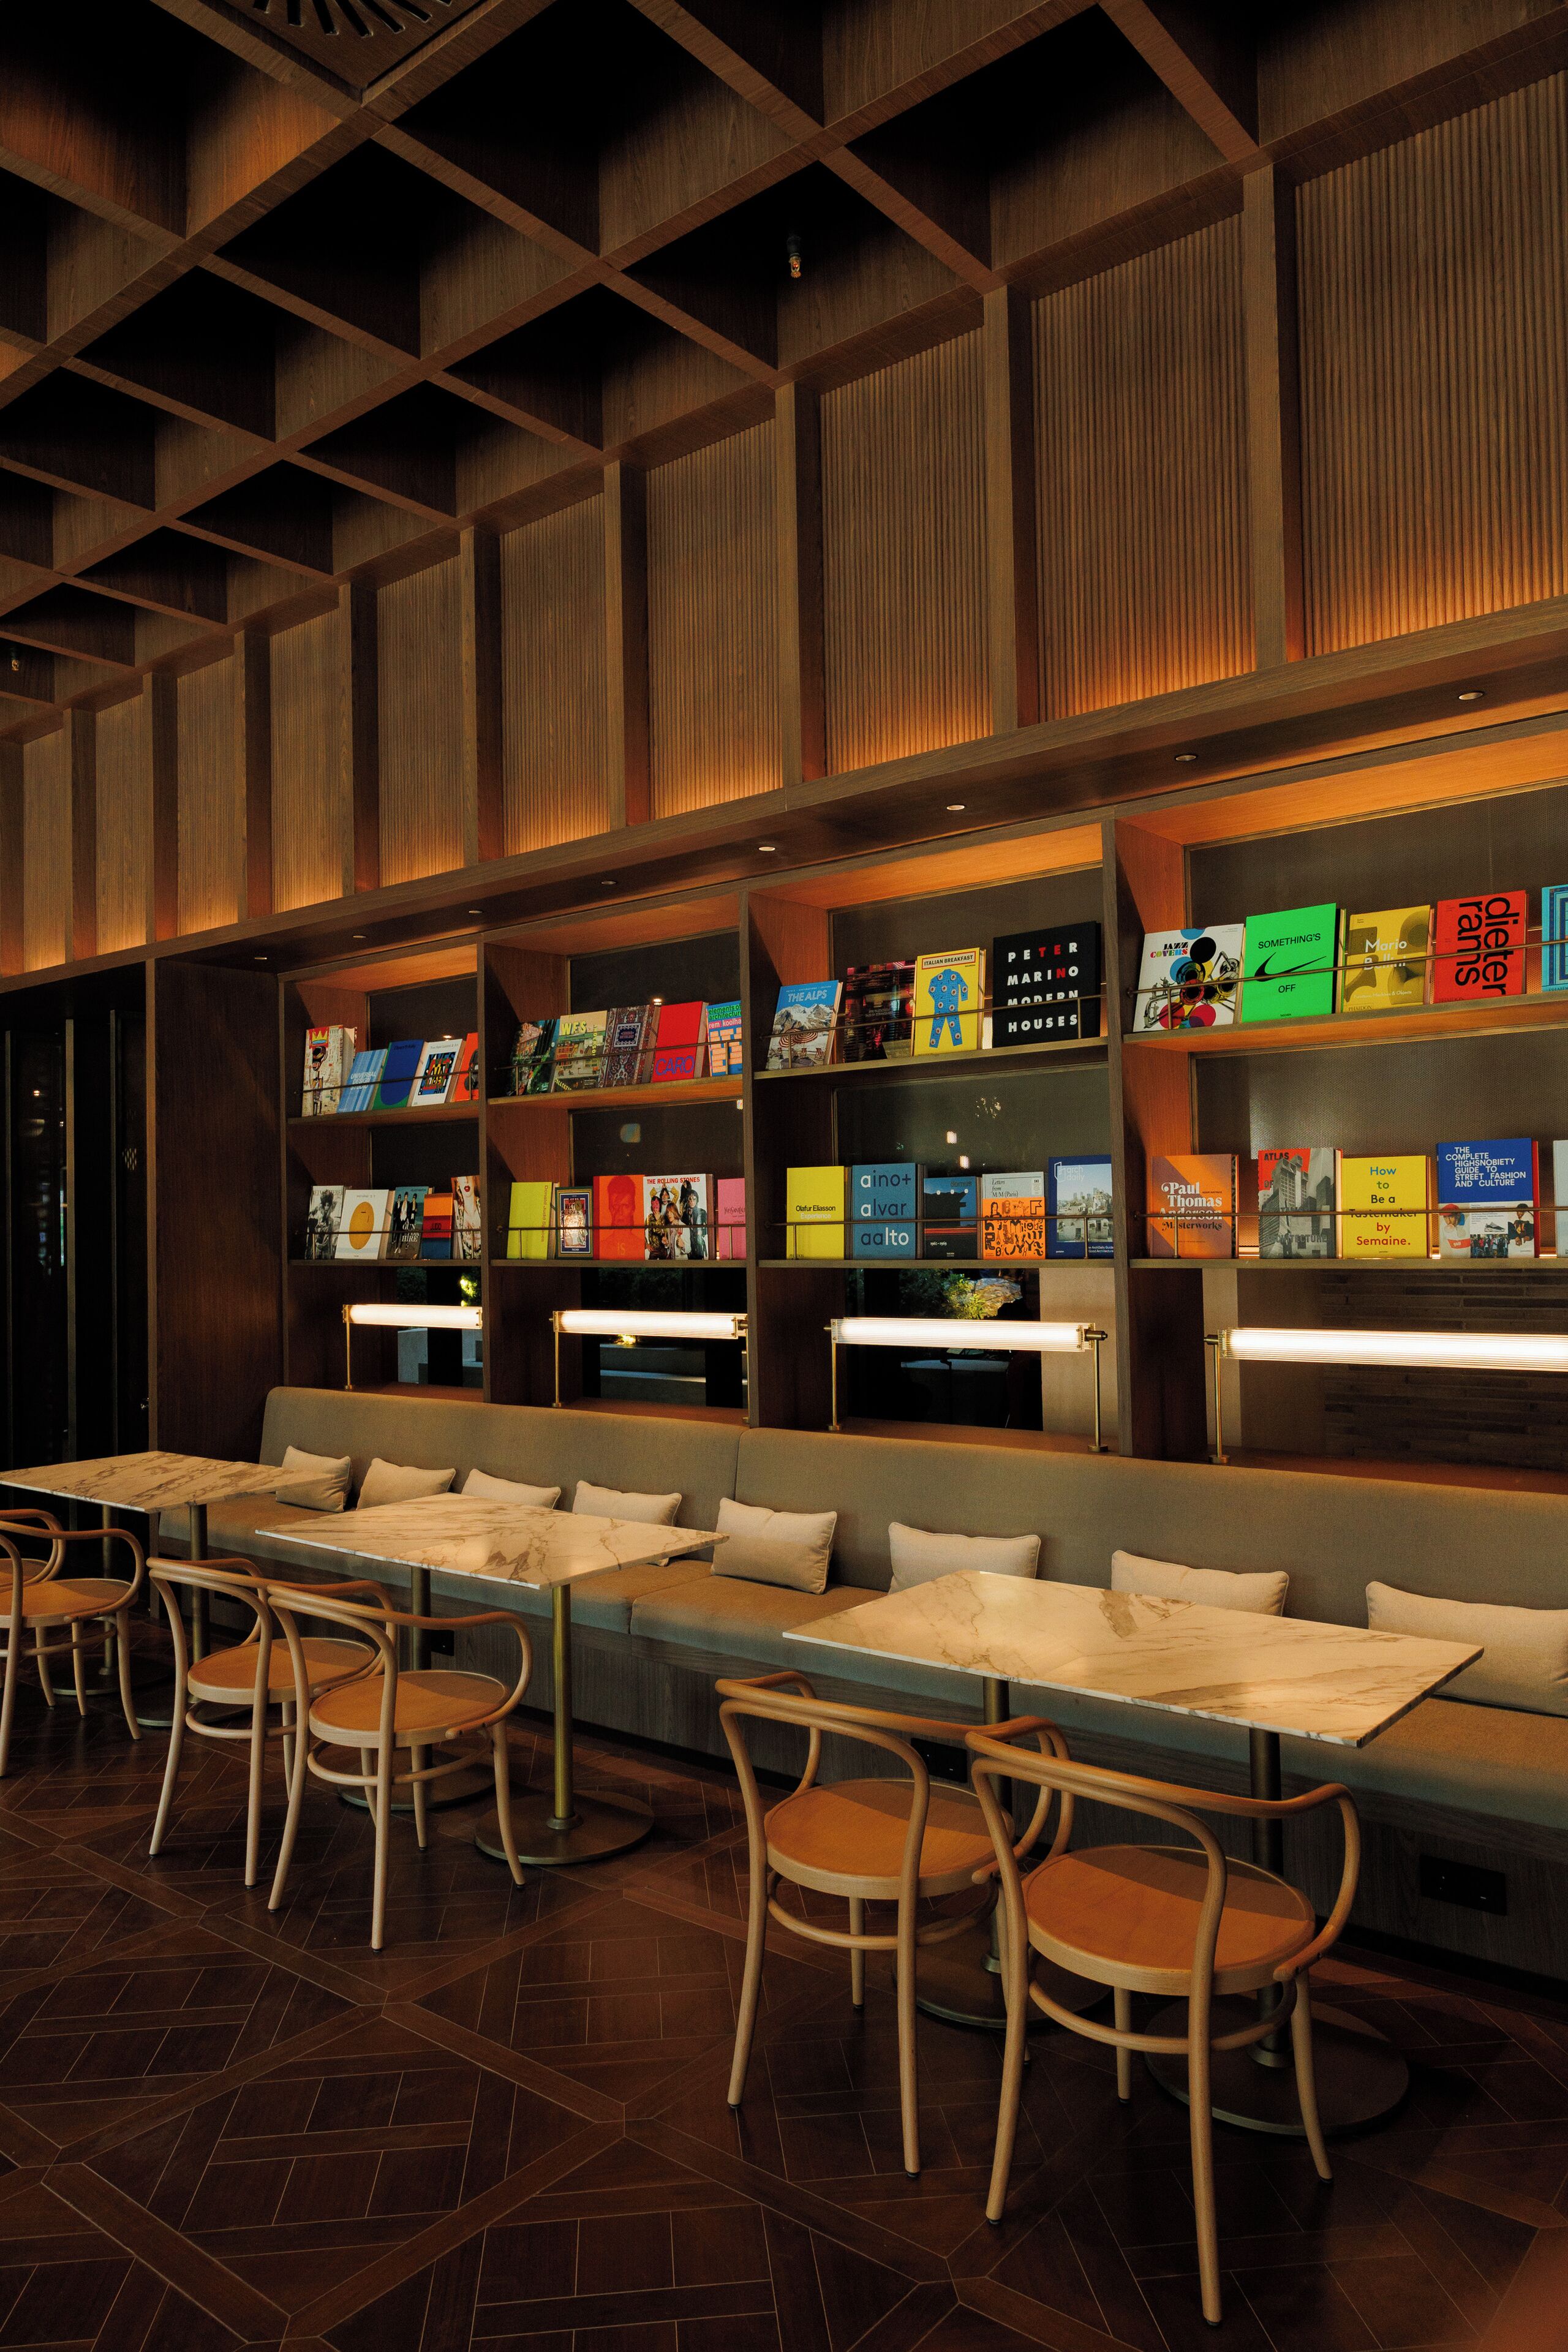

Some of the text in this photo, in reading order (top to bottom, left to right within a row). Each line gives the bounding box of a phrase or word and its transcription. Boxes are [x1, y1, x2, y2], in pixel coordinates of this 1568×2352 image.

[1258, 933, 1321, 949] SOMETHING'S
[1365, 938, 1408, 952] Mario
[1455, 901, 1483, 986] rams
[1482, 897, 1520, 995] dieter
[944, 955, 974, 963] BREAKFAST
[1008, 943, 1078, 962] PETER
[1150, 949, 1188, 958] COVERS
[1007, 966, 1079, 986] MARINO
[1278, 984, 1296, 993] OFF
[788, 989, 827, 1003] THE ALPS
[708, 1006, 735, 1015] elements
[1008, 1014, 1078, 1033] HOUSES
[655, 1055, 695, 1075] CARO
[1264, 1152, 1290, 1161] ATLAS
[1446, 1152, 1490, 1161] COMPLETE
[1455, 1158, 1515, 1167] HIGHSNOBIETY
[1370, 1166, 1396, 1175] How
[860, 1169, 911, 1188] aino+
[1161, 1182, 1200, 1194] Paul
[1167, 1194, 1223, 1207] Thomas
[1371, 1194, 1385, 1204] Be
[861, 1199, 907, 1217] alvar
[1158, 1207, 1223, 1220] Anderson
[1162, 1221, 1223, 1231] Msterworks
[1376, 1222, 1390, 1234] by
[861, 1227, 909, 1246] aalto
[1356, 1235, 1411, 1246] Semaine.
